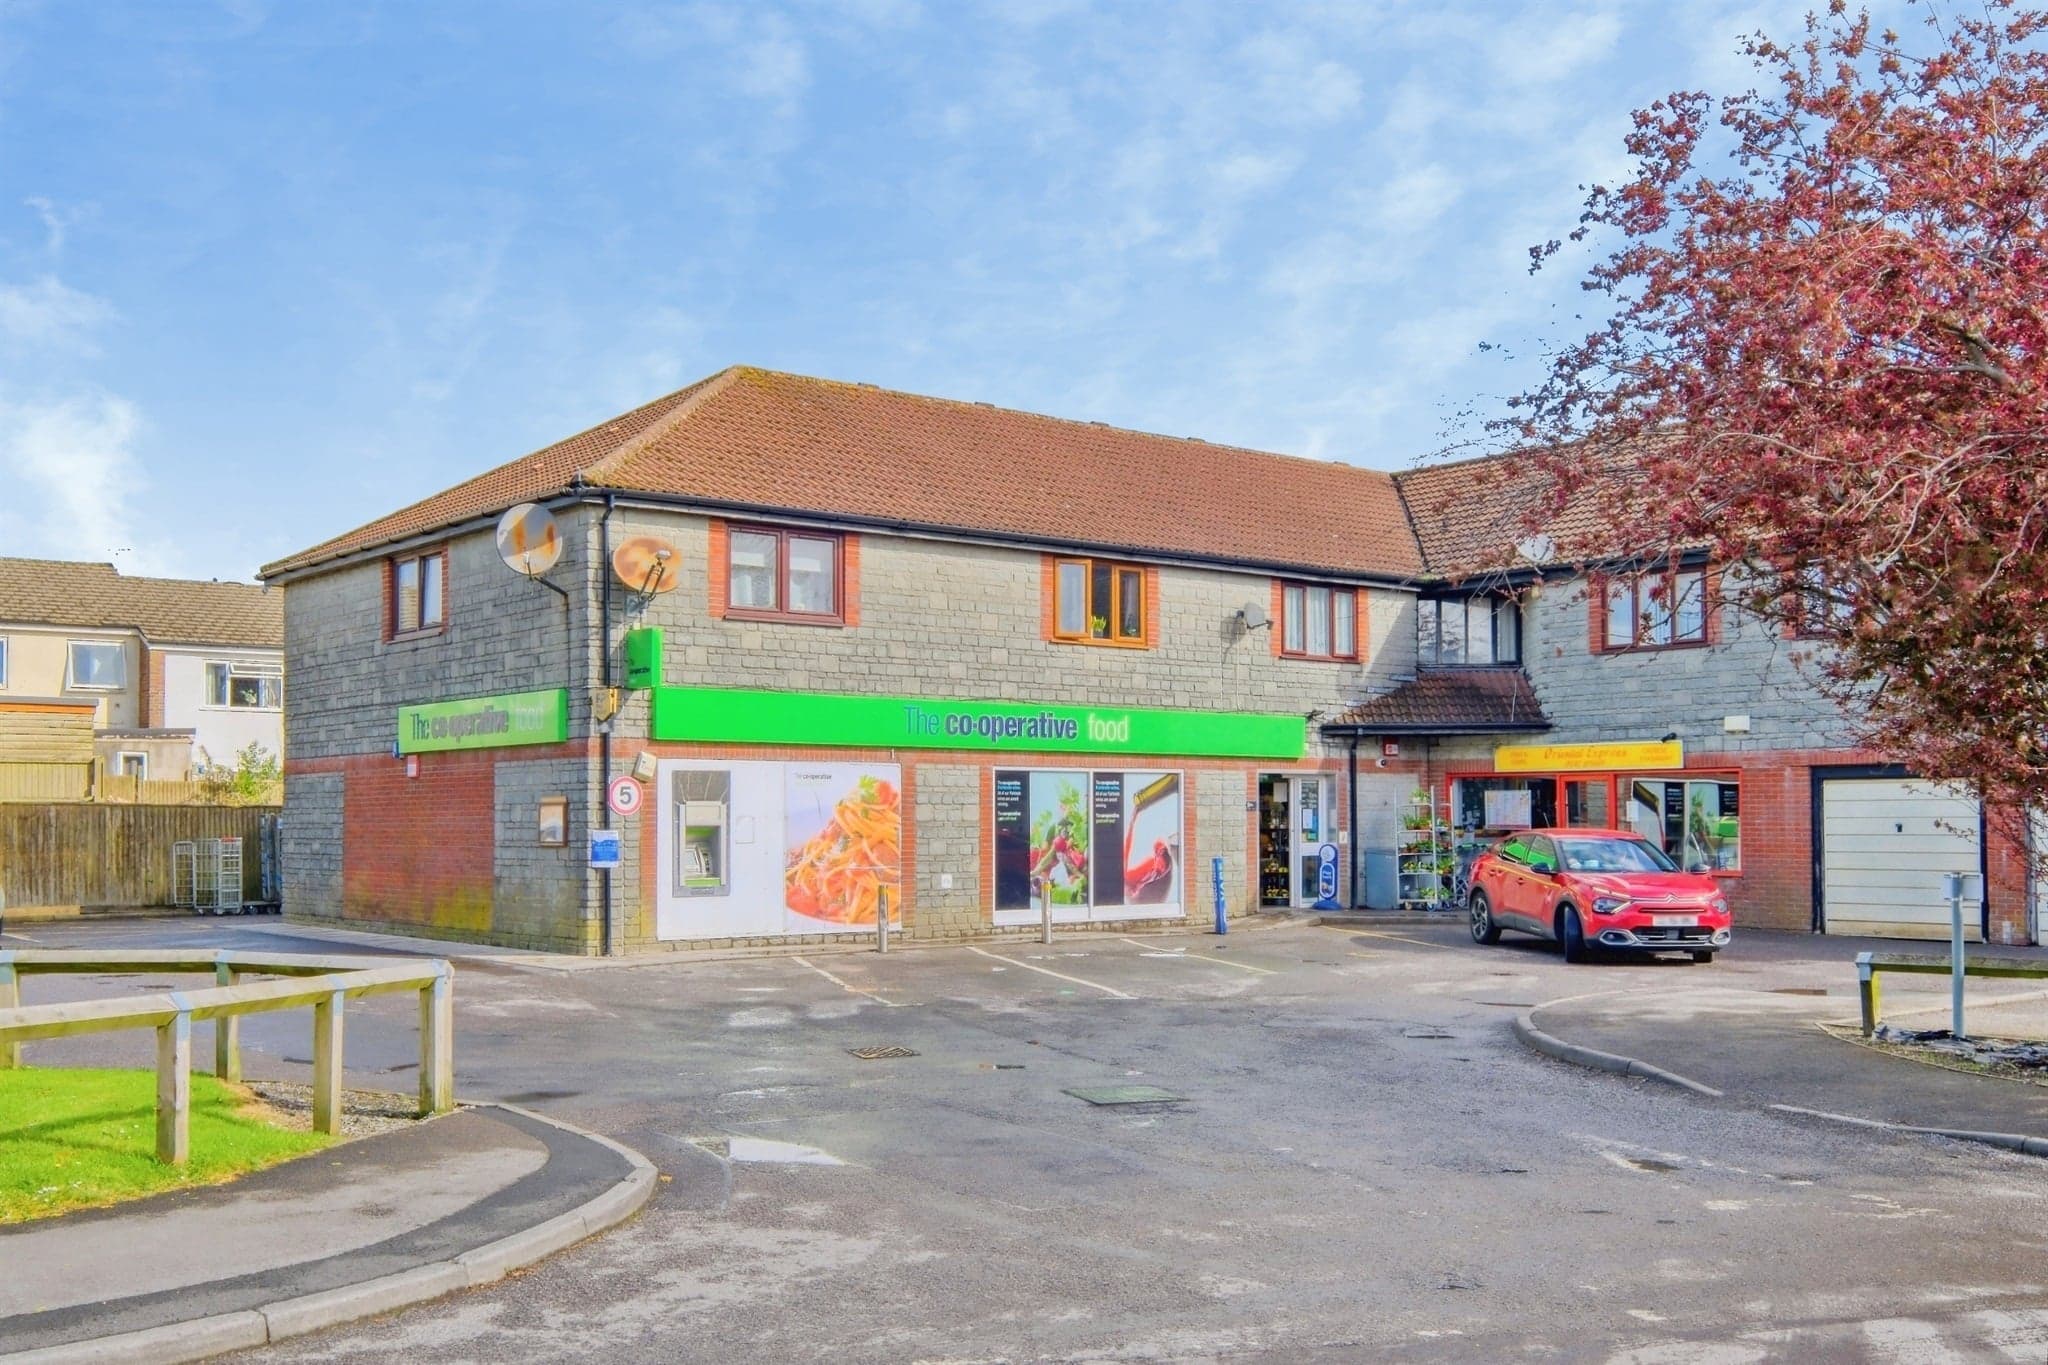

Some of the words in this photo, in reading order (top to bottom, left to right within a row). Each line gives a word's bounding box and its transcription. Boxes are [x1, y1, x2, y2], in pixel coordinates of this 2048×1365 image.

[410, 713, 430, 741] The
[904, 705, 940, 735] The
[944, 711, 1078, 743] co-operative
[1088, 712, 1129, 742] food
[619, 786, 632, 805] 5
